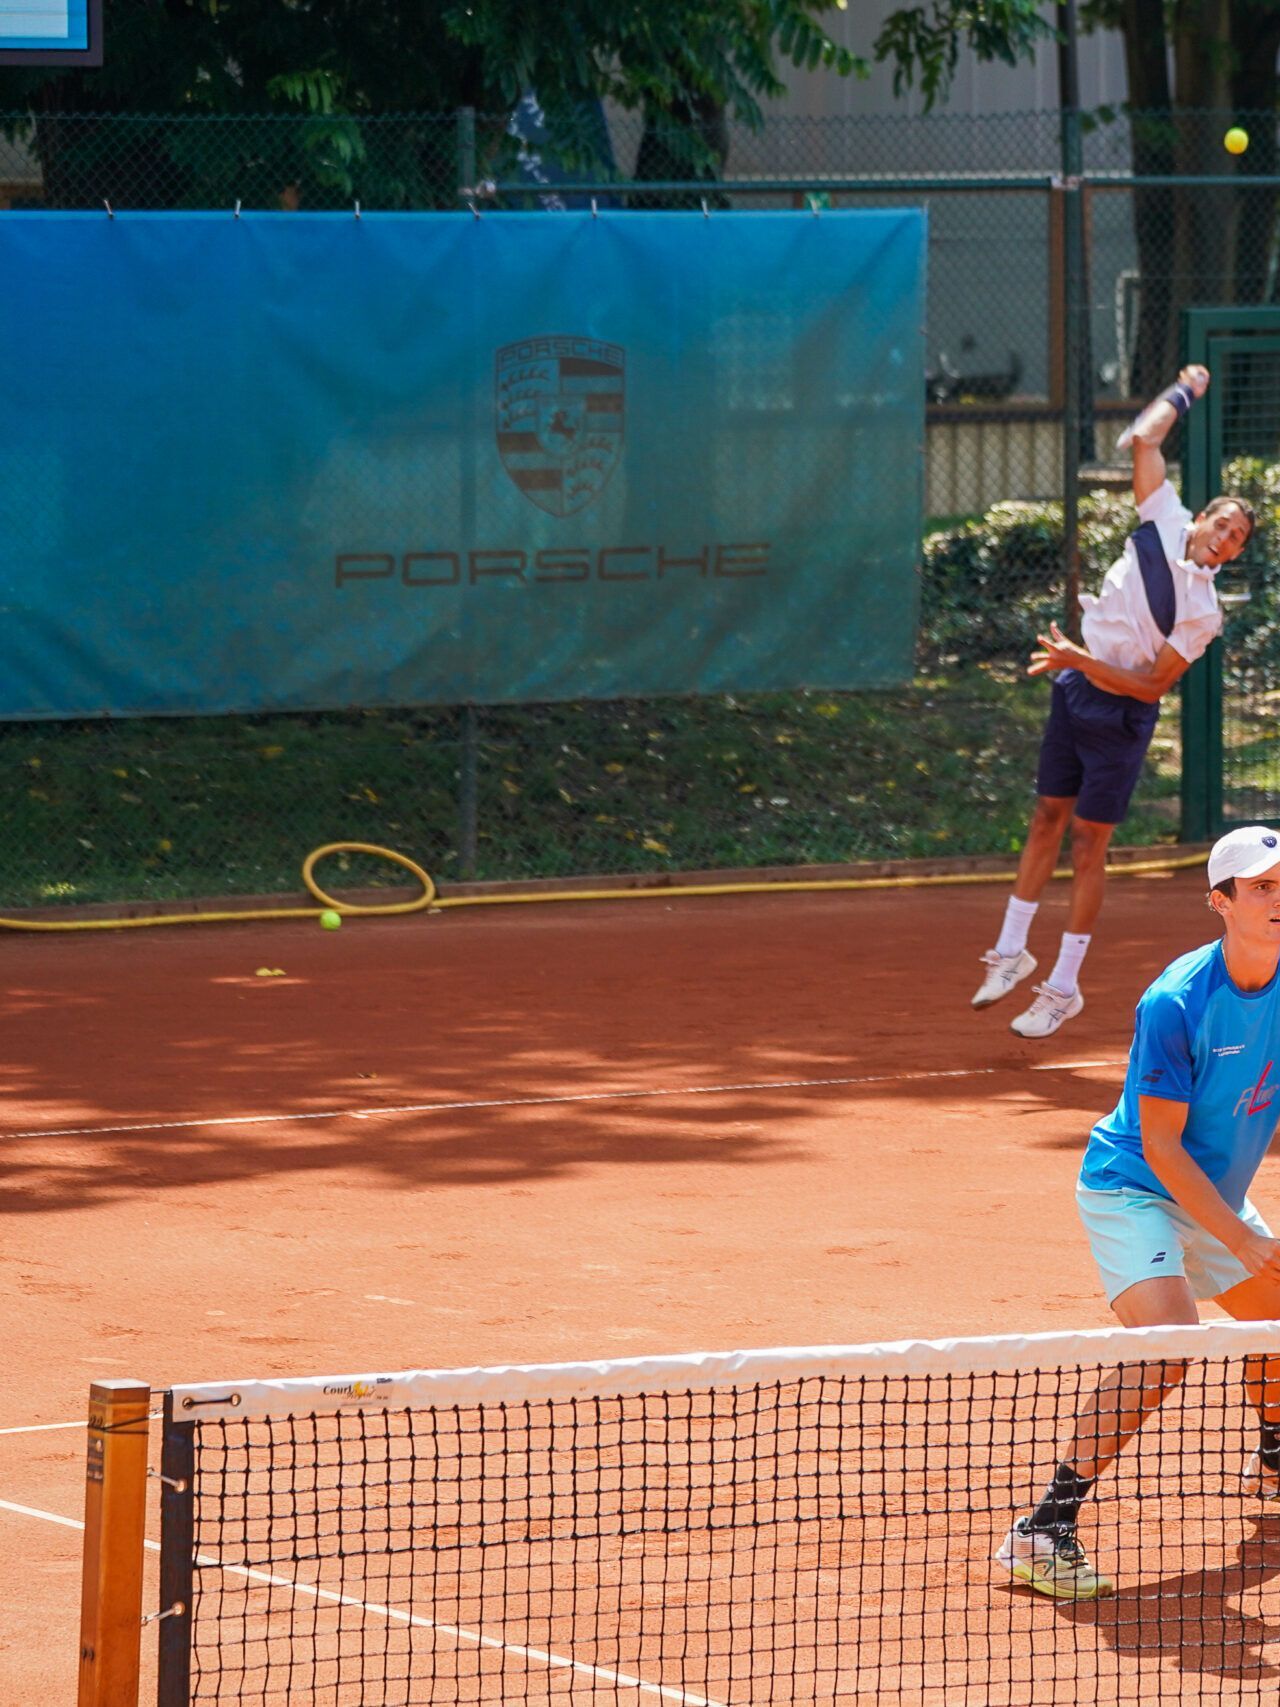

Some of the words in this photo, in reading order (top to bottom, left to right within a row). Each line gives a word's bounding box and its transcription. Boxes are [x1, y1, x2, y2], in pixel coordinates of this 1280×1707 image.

[501, 338, 623, 366] PORSCHE
[335, 543, 771, 588] PORSCHE
[323, 1385, 352, 1395] Court
